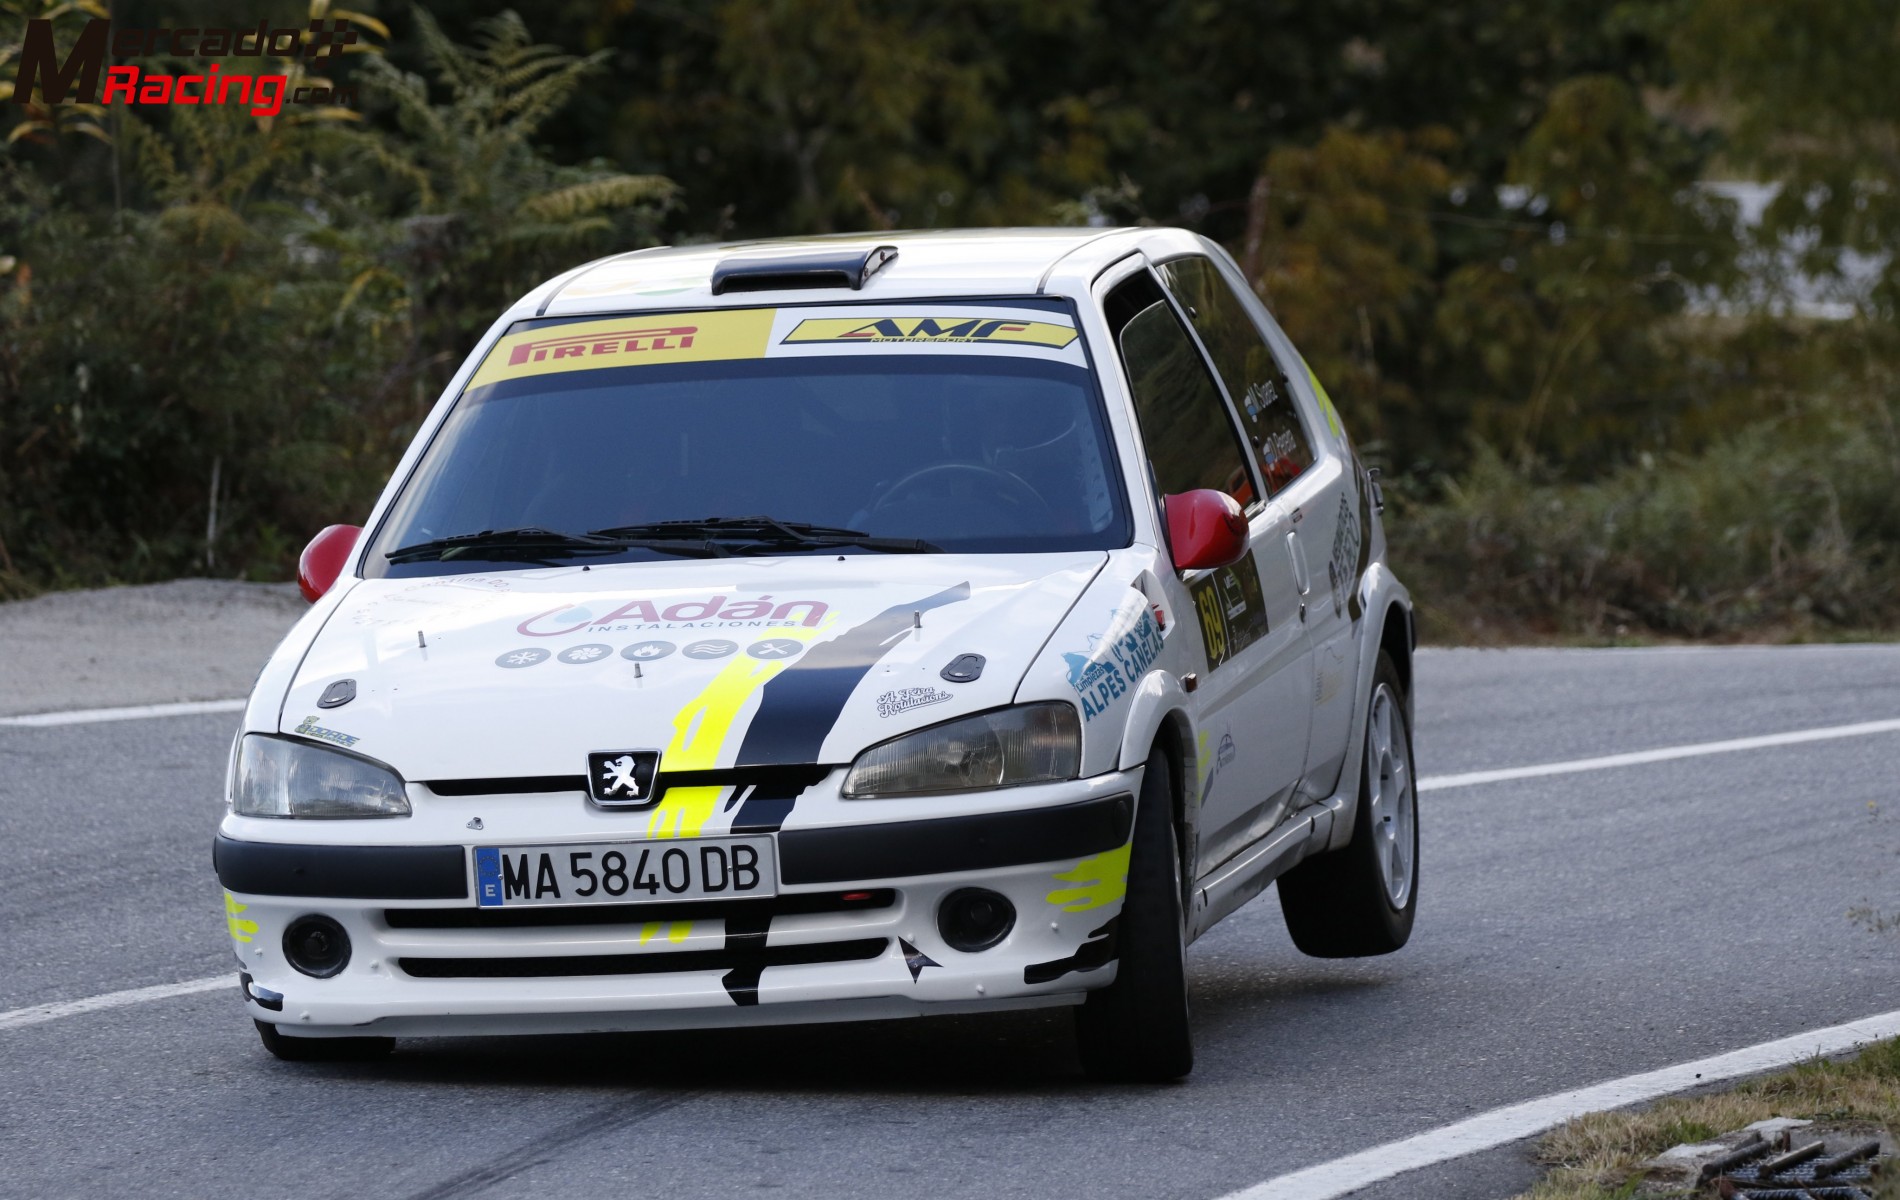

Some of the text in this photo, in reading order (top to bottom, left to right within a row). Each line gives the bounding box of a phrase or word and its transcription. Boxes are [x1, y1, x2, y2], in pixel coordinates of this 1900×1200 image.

[838, 318, 1031, 338] AMF
[508, 326, 698, 366] PIRELLI
[587, 620, 795, 633] INSTALACIONES
[591, 594, 829, 627] Adán
[1198, 585, 1226, 659] 69
[1074, 665, 1105, 692] Limpiezas
[1081, 626, 1165, 722] ALPES CANELAS
[502, 844, 760, 899] MA 5840 DB
[485, 884, 496, 896] E
